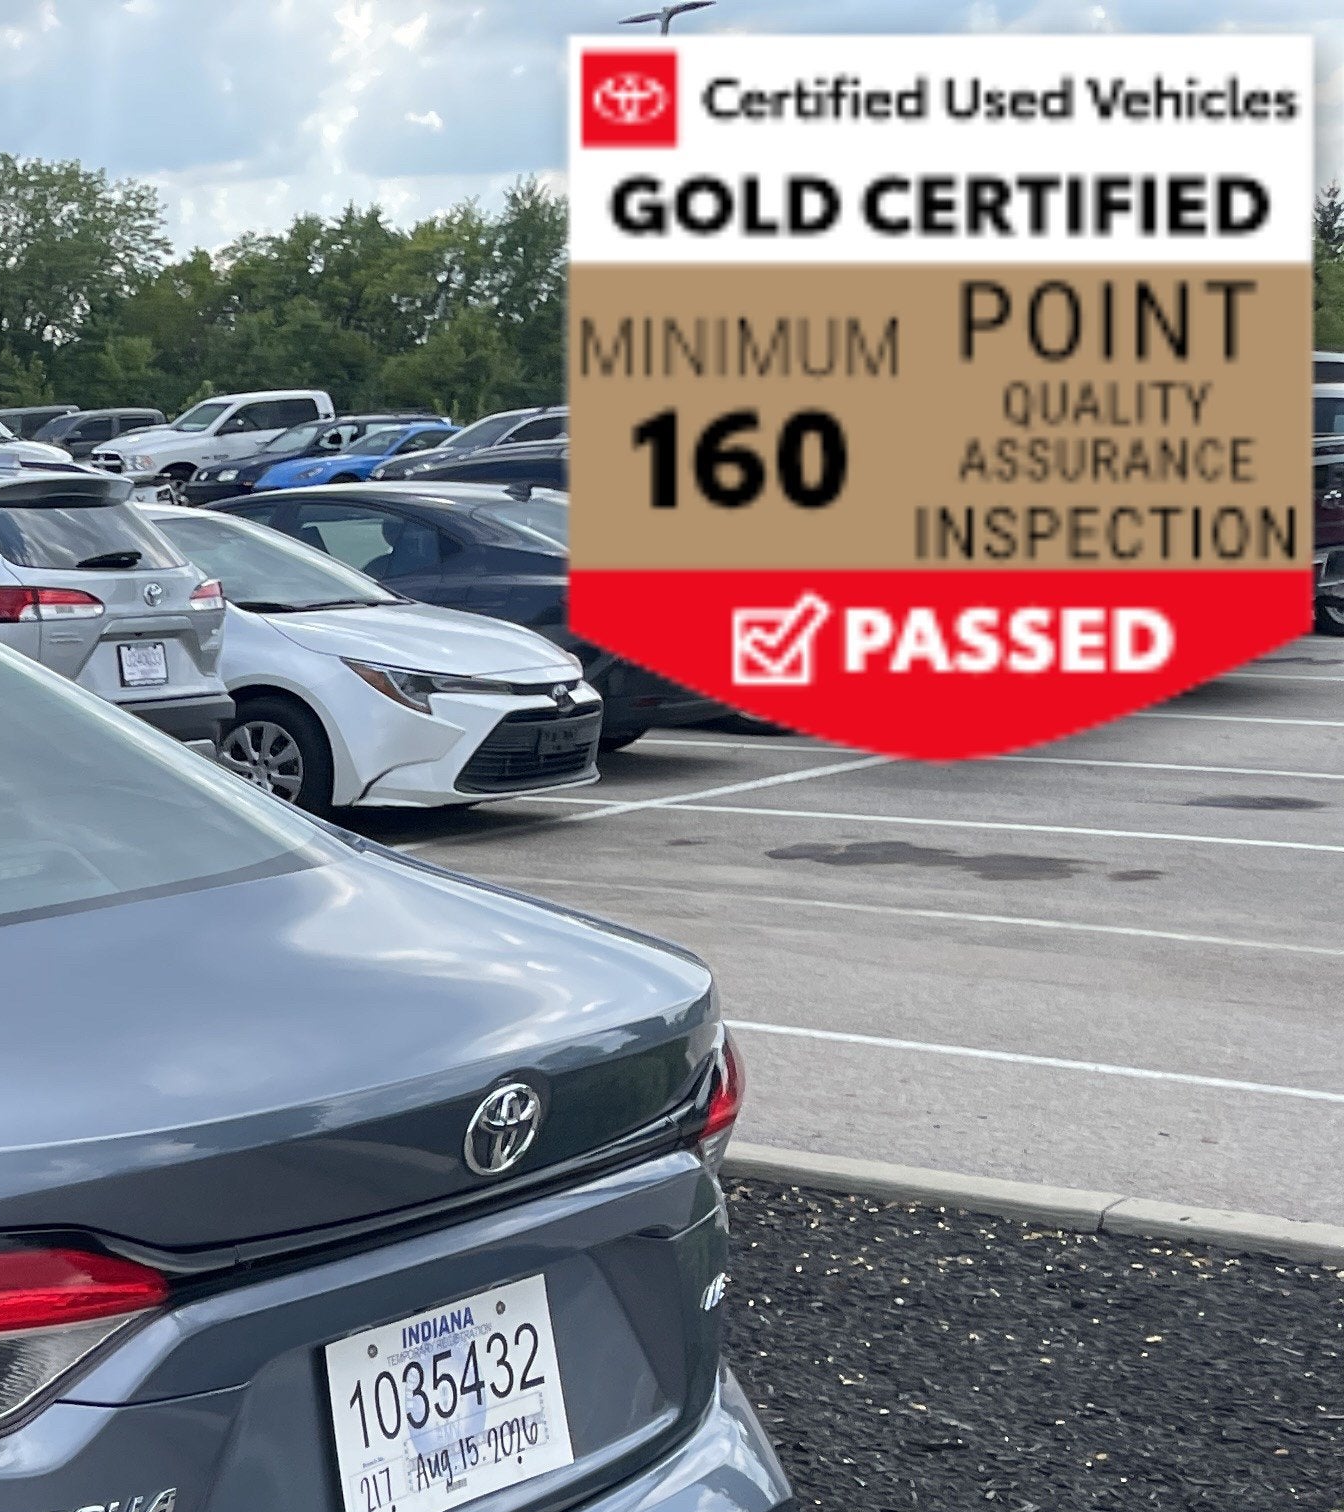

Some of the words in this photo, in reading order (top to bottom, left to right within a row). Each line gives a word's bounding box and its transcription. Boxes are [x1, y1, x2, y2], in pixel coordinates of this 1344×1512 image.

[402, 1306, 475, 1349] INDIANA
[349, 1322, 545, 1449] 1035432
[487, 1416, 538, 1465] 2026
